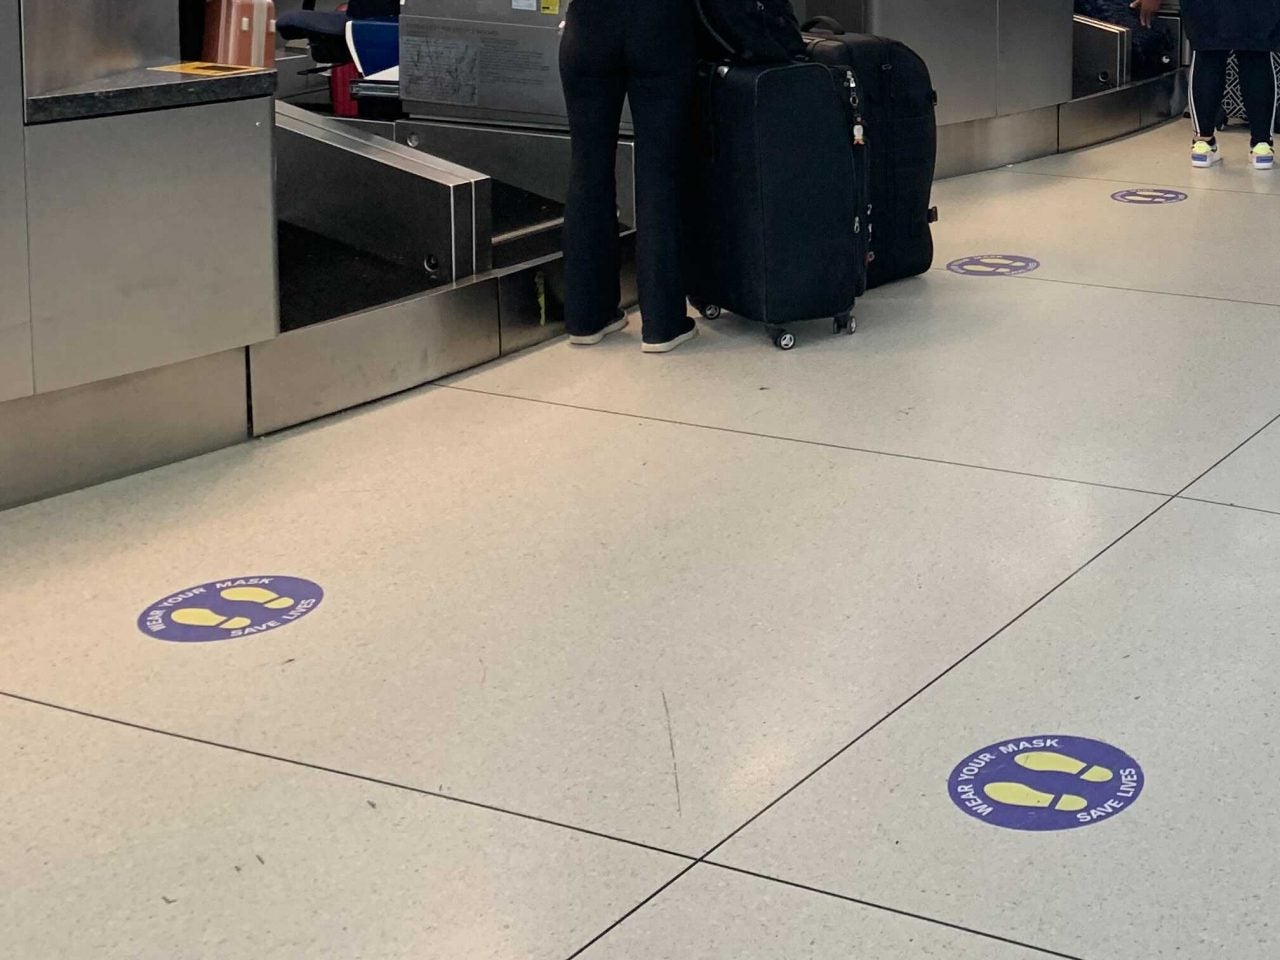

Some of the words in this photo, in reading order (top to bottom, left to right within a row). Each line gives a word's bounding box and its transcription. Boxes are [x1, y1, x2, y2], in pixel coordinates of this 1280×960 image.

[163, 587, 208, 609] YOUR
[215, 577, 275, 589] MASK
[230, 620, 281, 637] SAVE
[282, 597, 316, 620] LIVES
[998, 738, 1060, 755] MASK
[957, 752, 996, 783] YOUR
[956, 783, 994, 817] WEAR
[1076, 798, 1124, 823] SAVE
[1117, 767, 1137, 798] LIVES
